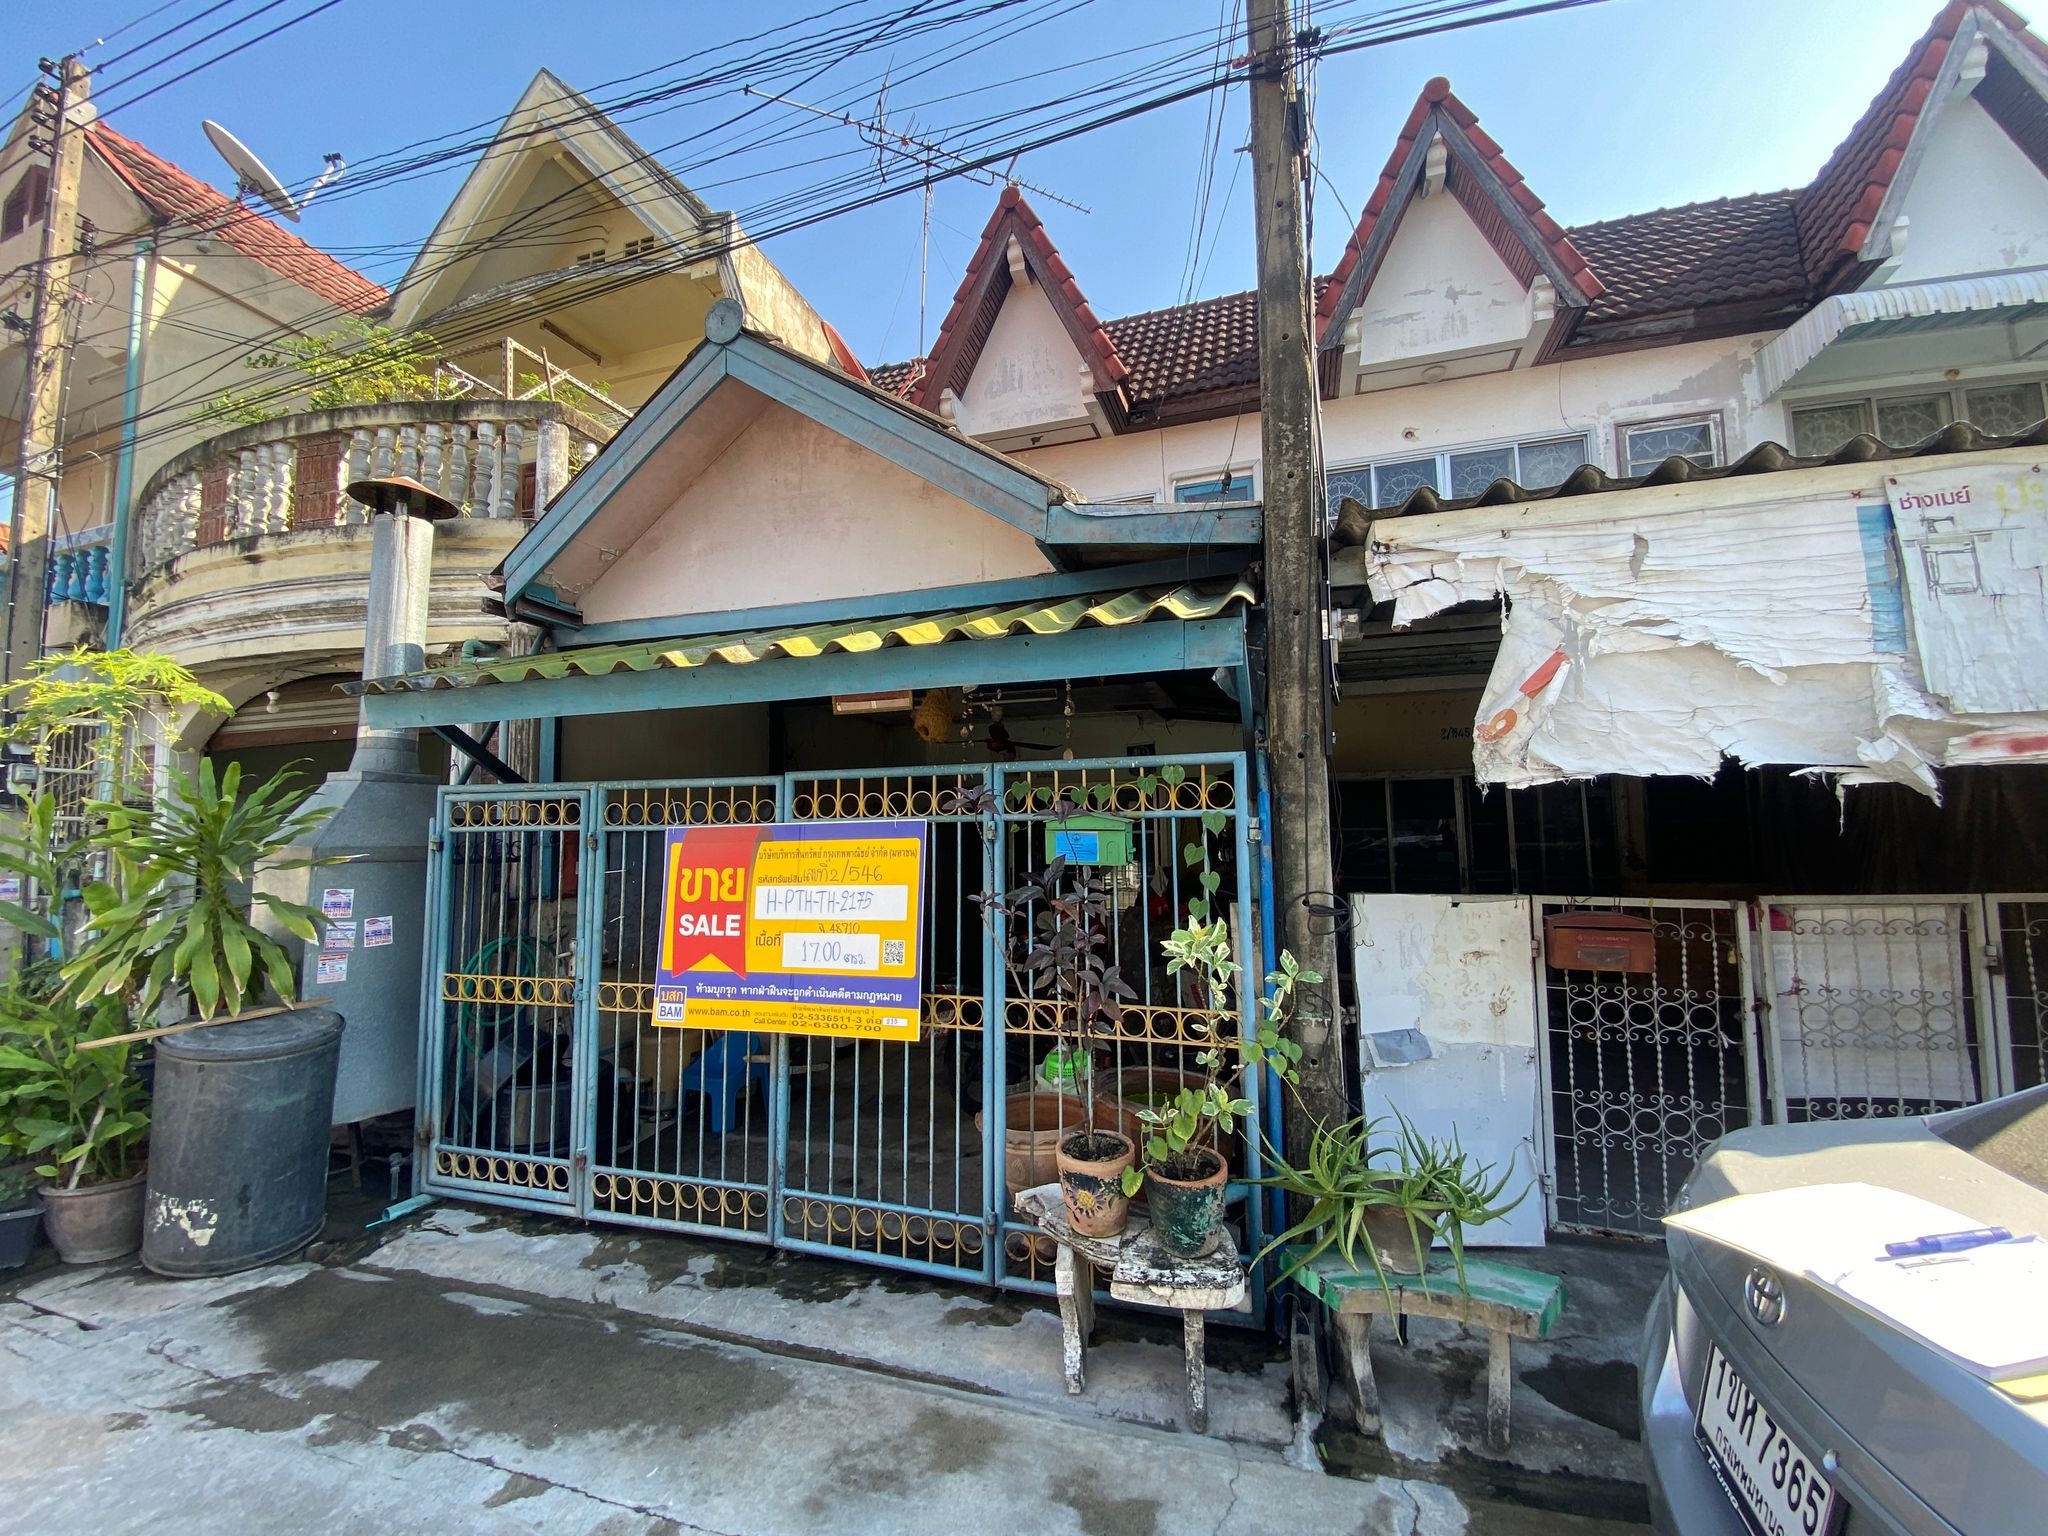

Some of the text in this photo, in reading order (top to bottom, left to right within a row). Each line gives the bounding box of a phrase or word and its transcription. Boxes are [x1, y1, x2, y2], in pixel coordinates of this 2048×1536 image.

[871, 845, 888, 858] จำกัด
[889, 848, 917, 859] (มหาชน)
[680, 867, 745, 903] ขาย
[679, 913, 741, 937] SALE
[755, 930, 782, 946] เนื้อที่
[660, 989, 684, 1002] บสก
[695, 982, 737, 998] ห้ามบุกรุก
[659, 1005, 682, 1018] BAM
[688, 1007, 751, 1017] www.bam.co.th
[767, 1018, 787, 1026] Center
[791, 1020, 882, 1032] 02-6300-700
[1758, 1414, 1826, 1536] 7365
